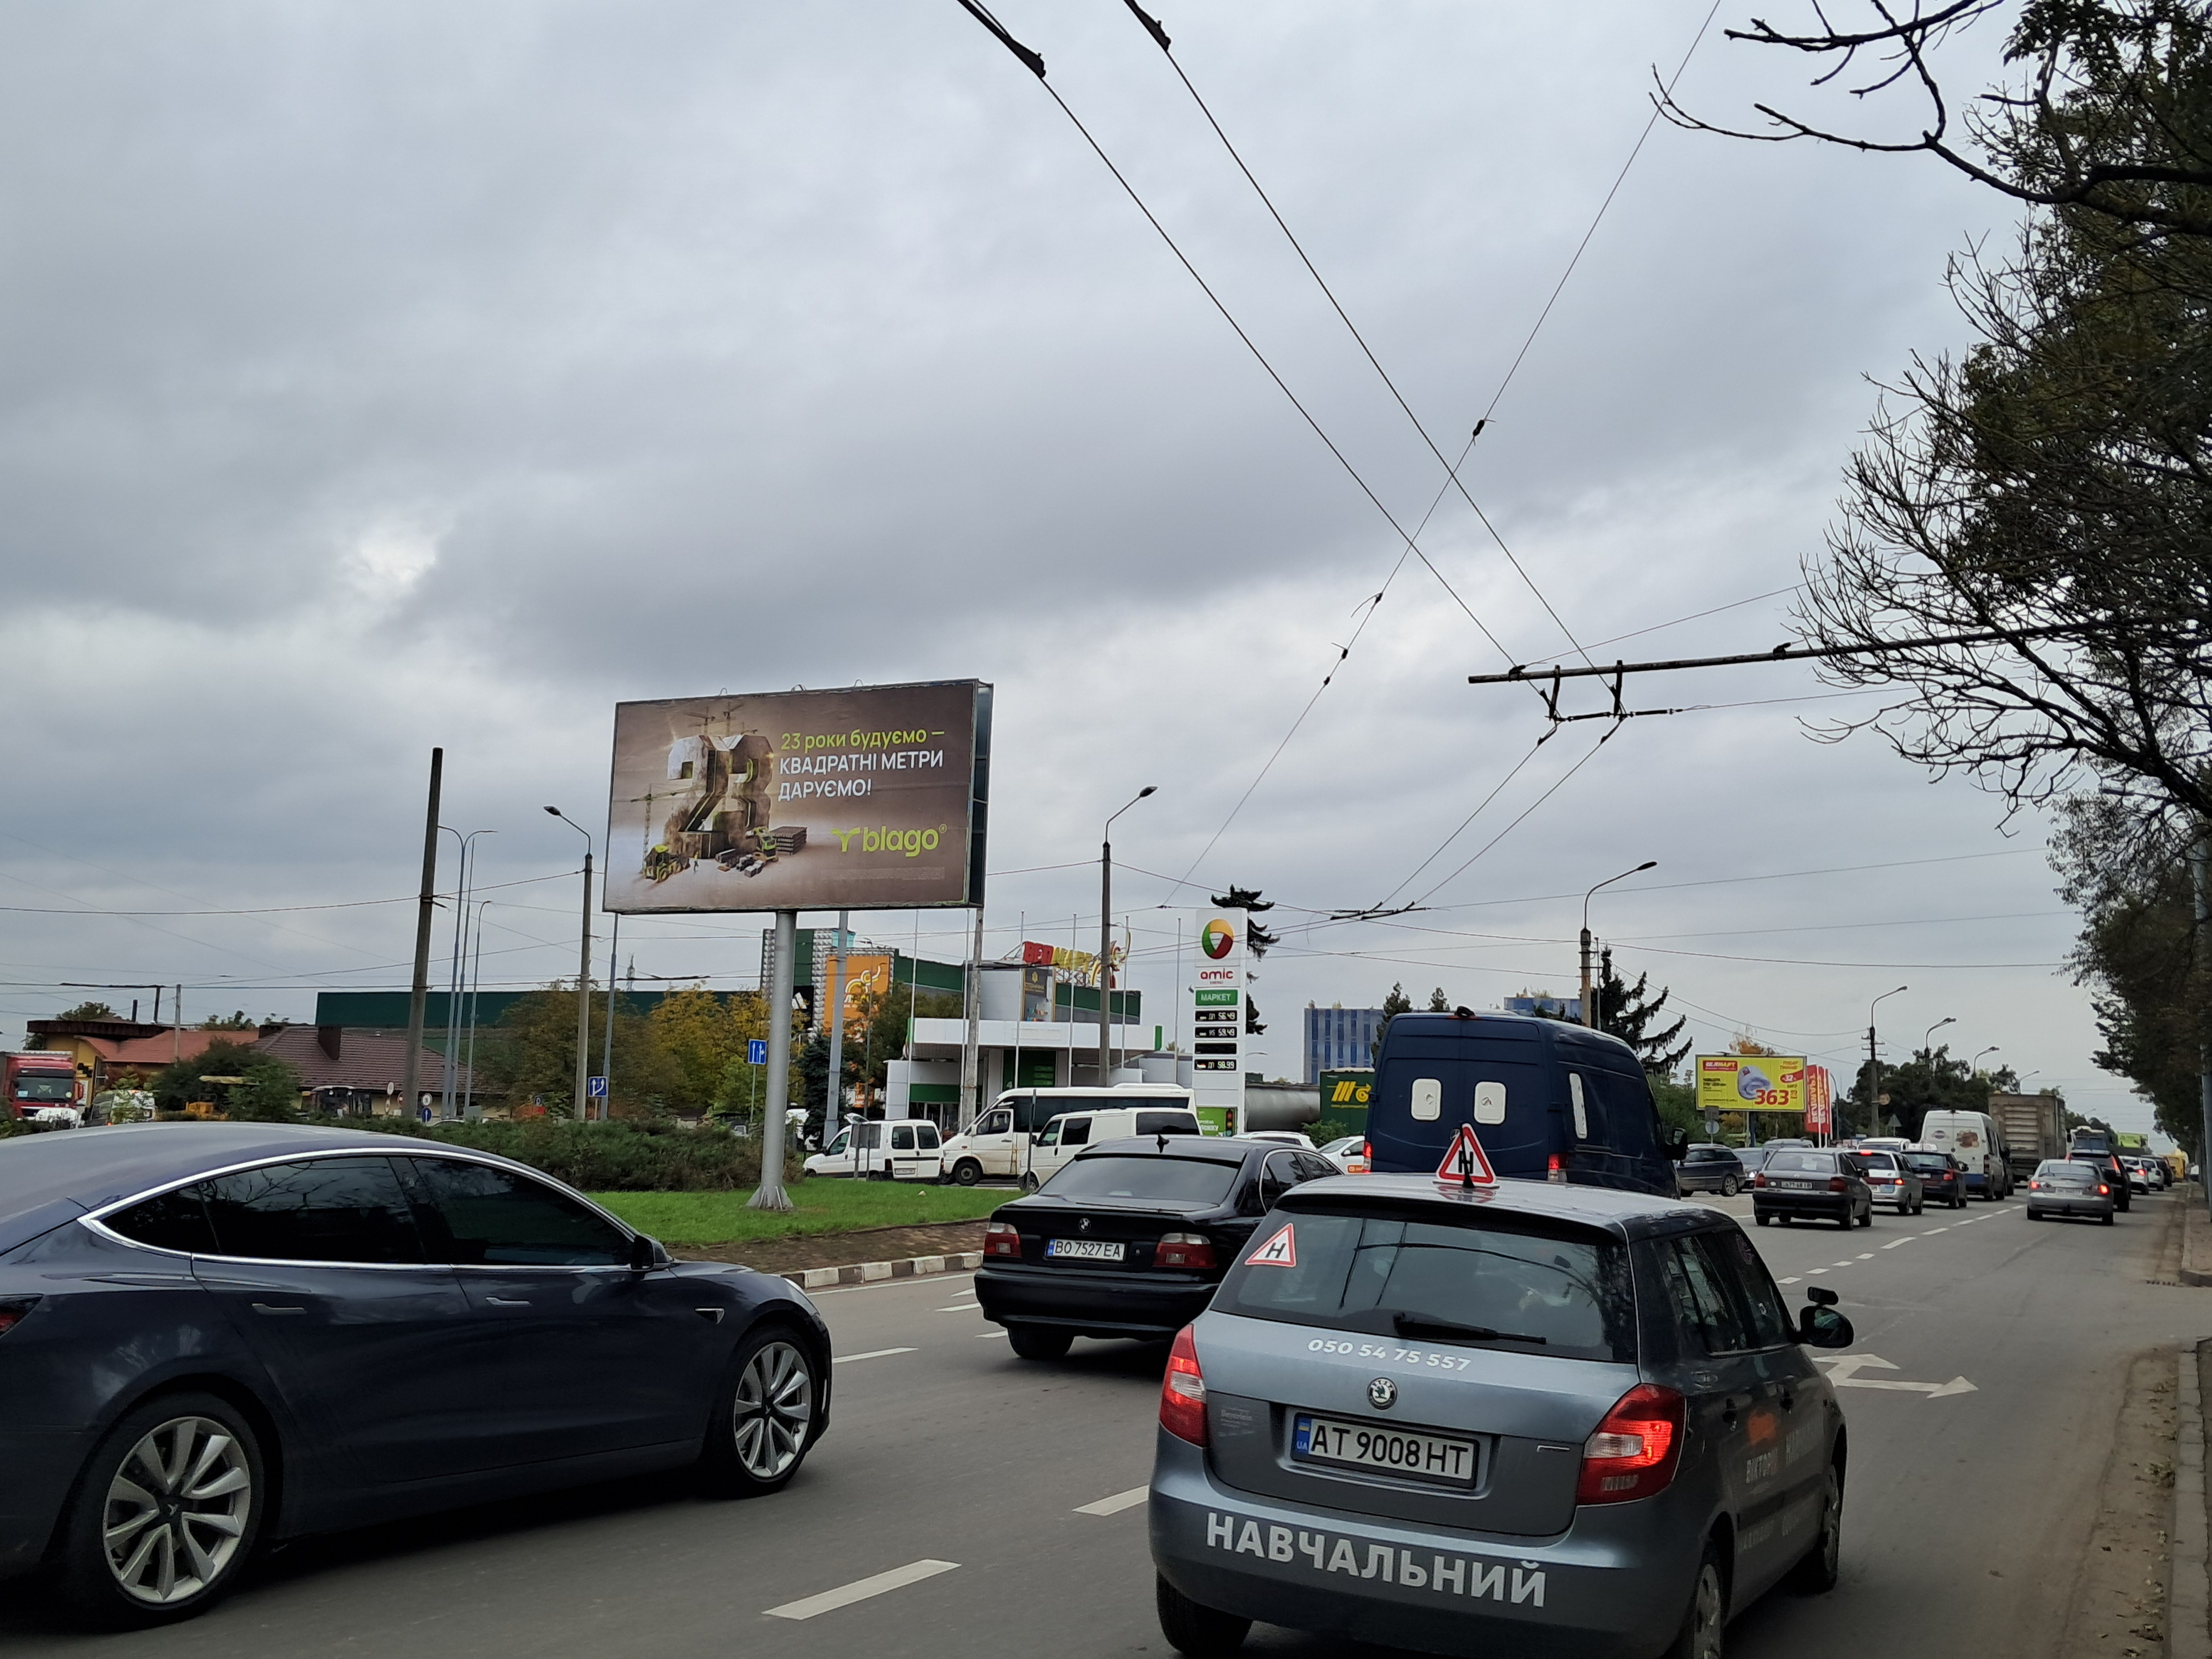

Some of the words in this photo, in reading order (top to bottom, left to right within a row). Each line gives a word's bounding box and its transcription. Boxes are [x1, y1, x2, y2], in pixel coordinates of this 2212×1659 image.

[781, 732, 801, 750] 23
[805, 734, 846, 753] роки
[850, 729, 927, 751] будуємо
[780, 753, 877, 775] КВАДРАТНІ
[882, 749, 944, 770] МЕТРИ
[778, 779, 872, 802] ДАРУЄМО!
[863, 825, 939, 857] blago
[1200, 967, 1233, 980] amic
[1200, 993, 1231, 1001] МАРКЕТ
[1754, 1089, 1789, 1105] 363
[1458, 1150, 1474, 1174] Н
[1055, 1241, 1072, 1255] BO
[1075, 1242, 1102, 1256] 7527
[1103, 1243, 1121, 1258] EA
[1264, 1242, 1287, 1259] Н
[1307, 1339, 1354, 1354] 050
[1358, 1344, 1386, 1359] 54
[1393, 1348, 1422, 1364] 75
[1425, 1353, 1472, 1371] 557
[1296, 1440, 1308, 1451] UA
[1310, 1425, 1352, 1456] AT
[1356, 1431, 1420, 1467] 9008
[1425, 1442, 1469, 1475] HT
[1206, 1512, 1546, 1608] НАВЧАЛЬНИЙ
